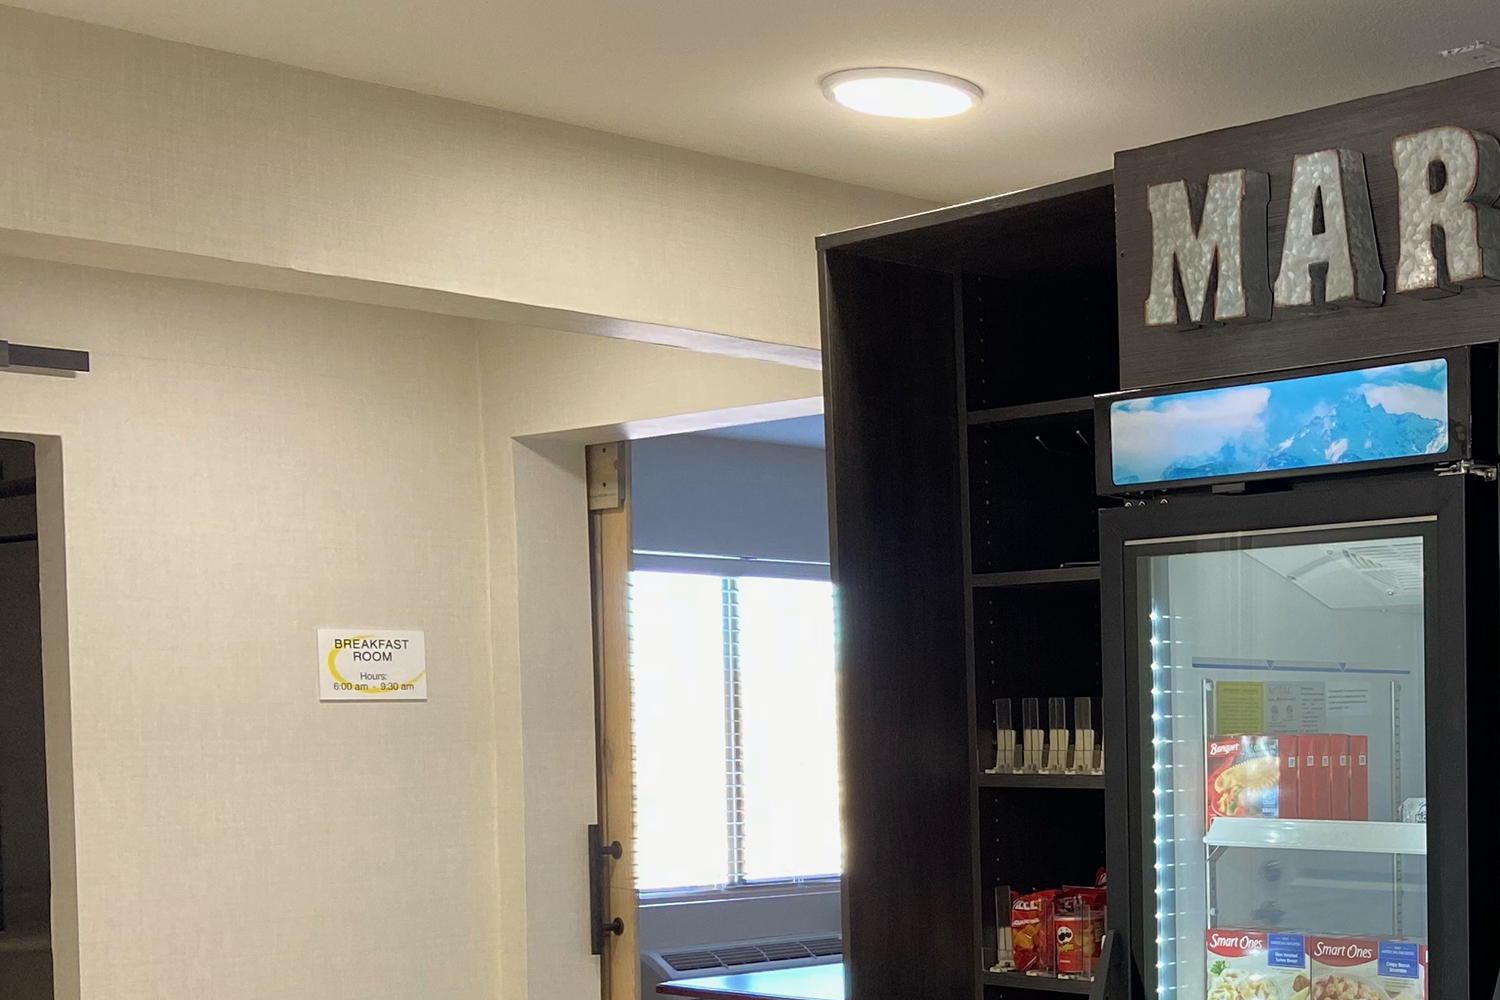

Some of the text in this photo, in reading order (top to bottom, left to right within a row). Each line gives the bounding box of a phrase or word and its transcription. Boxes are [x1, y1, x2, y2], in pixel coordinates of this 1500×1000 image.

[334, 639, 409, 649] BREAKFAST
[353, 651, 393, 661] ROOM
[360, 672, 388, 680] Hours:
[333, 682, 353, 691] 6:00
[380, 682, 399, 691] 9:30
[1210, 743, 1240, 755] Banquet
[1209, 933, 1239, 948] Smart
[1240, 935, 1262, 949] Ones
[1314, 941, 1345, 957] Smart
[1346, 944, 1372, 959] Ones
